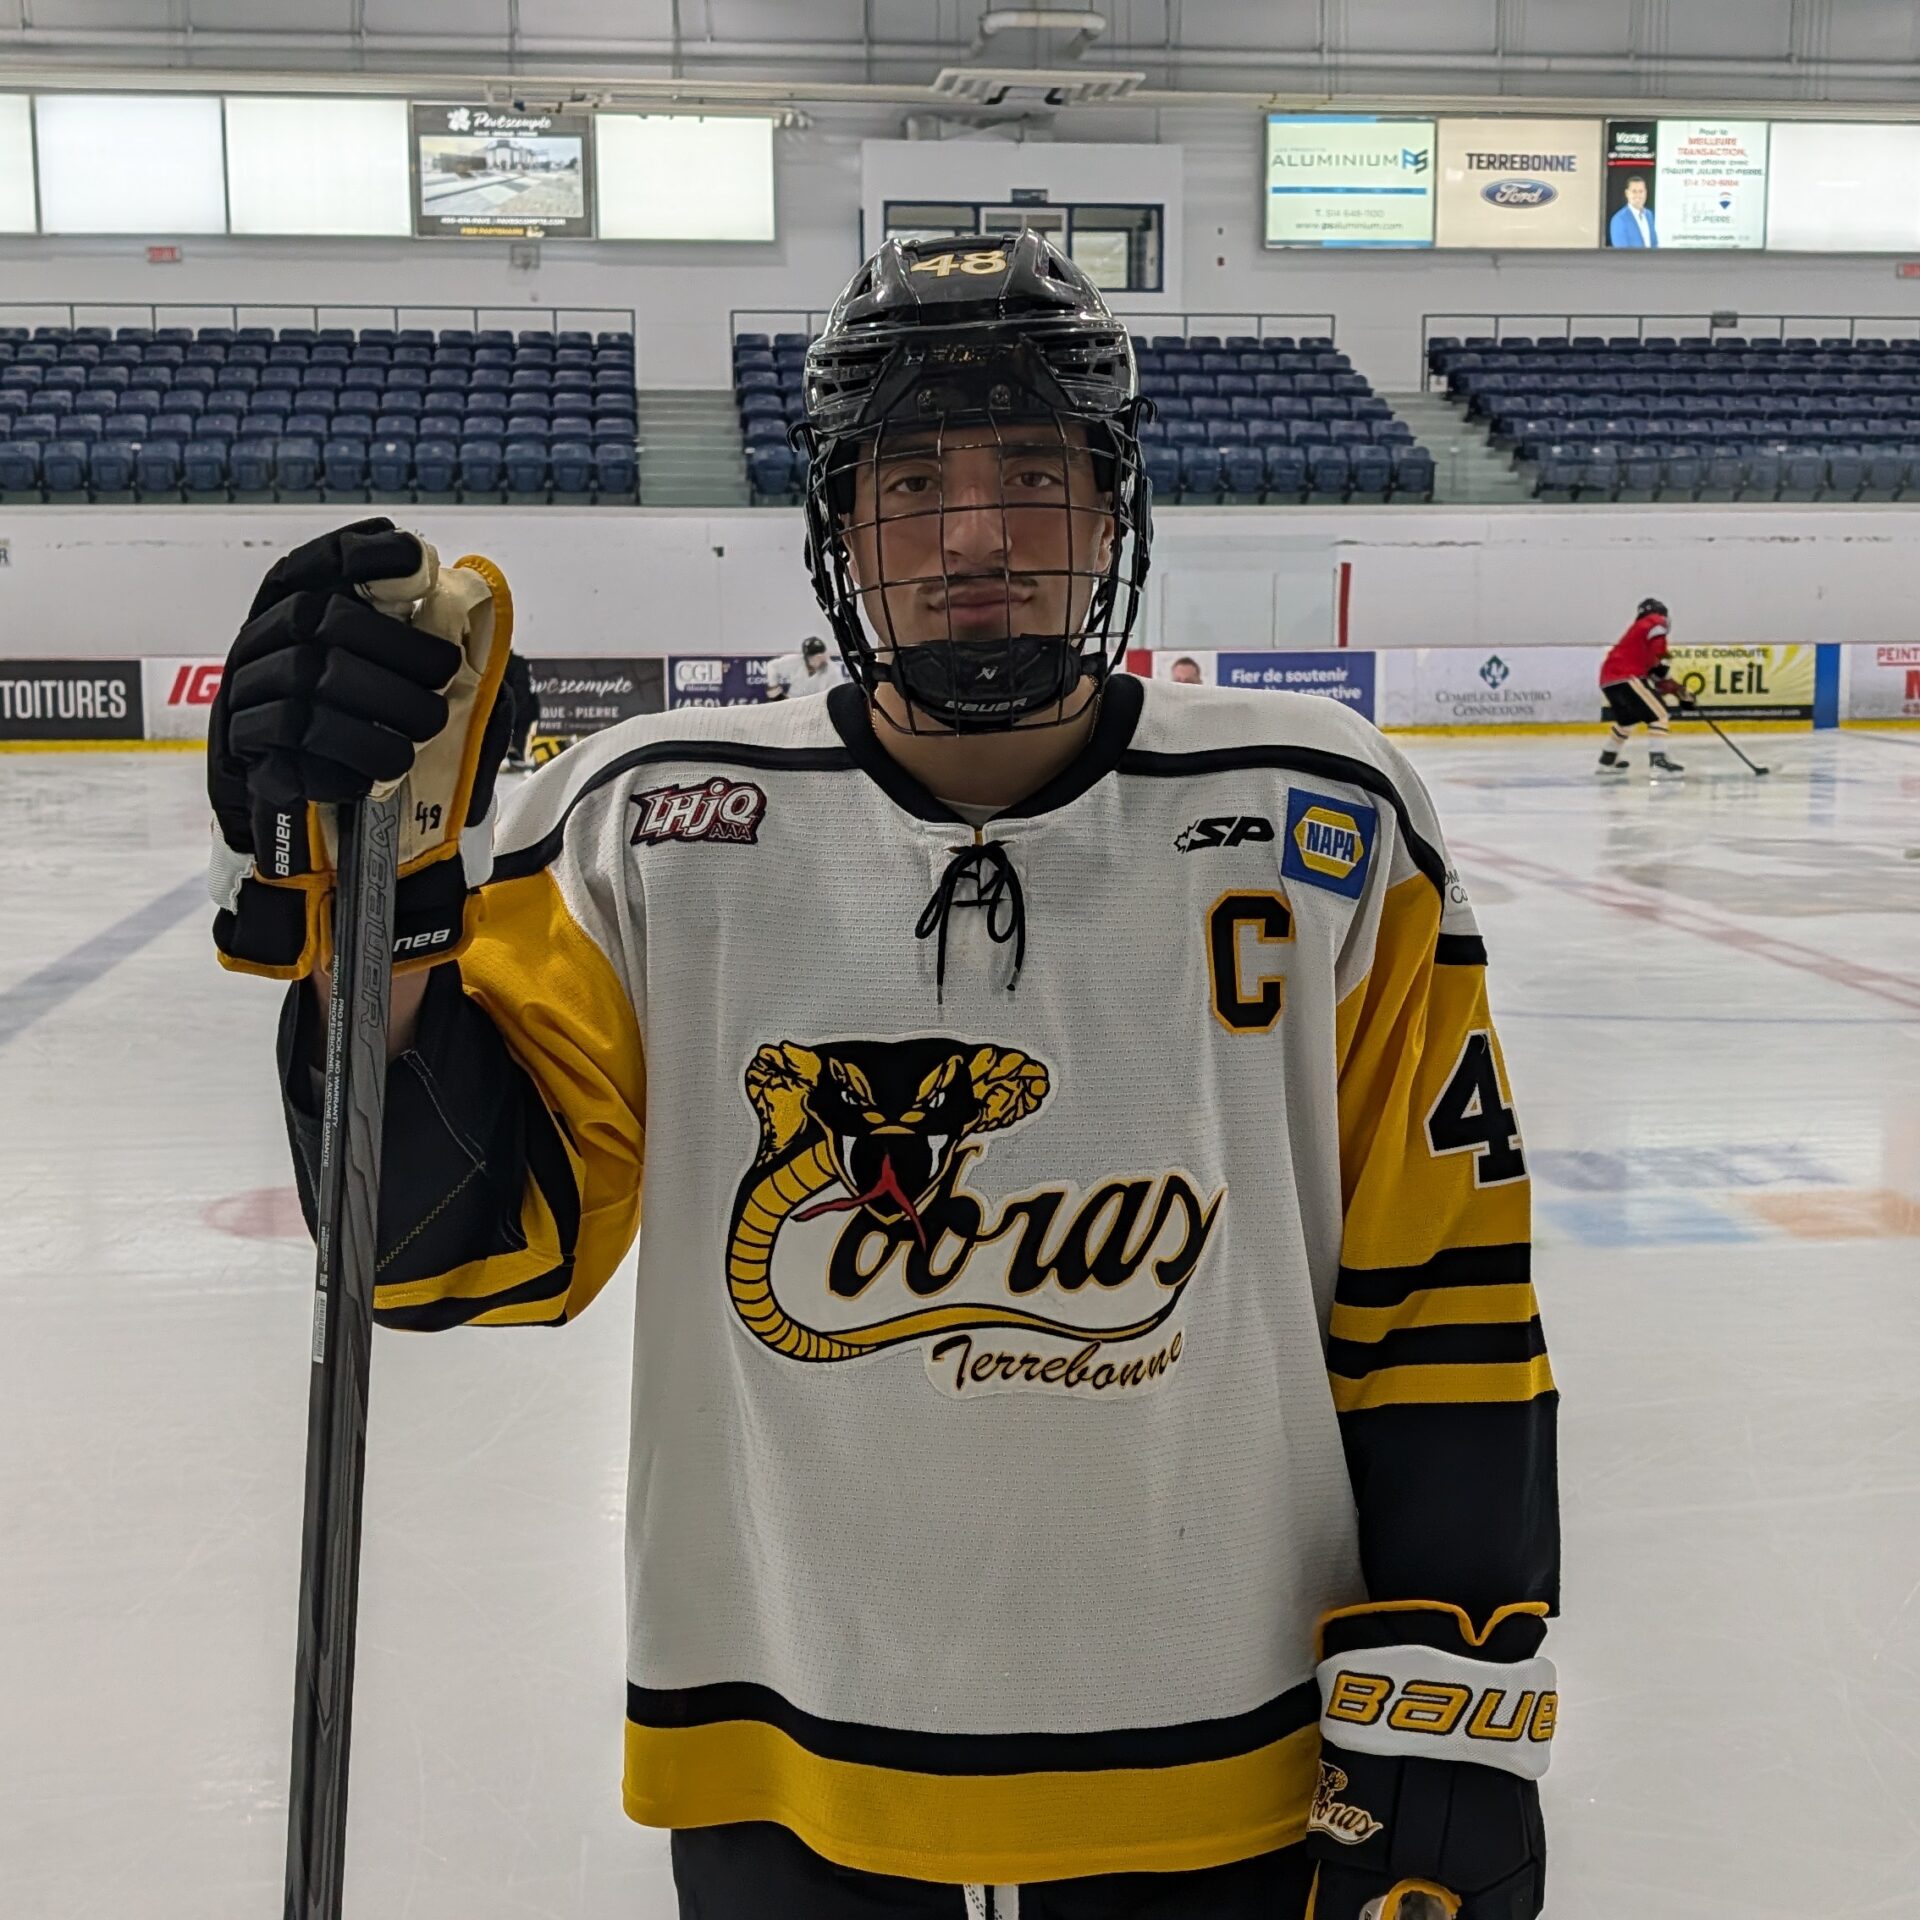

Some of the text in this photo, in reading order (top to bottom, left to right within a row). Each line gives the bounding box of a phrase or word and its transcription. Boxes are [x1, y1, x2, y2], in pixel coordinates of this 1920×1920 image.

[1271, 154, 1399, 168] ALUMINIUM
[1465, 153, 1577, 172] TERREBONNE
[1494, 182, 1542, 205] Ford
[910, 250, 1008, 277] 48
[1712, 648, 1769, 658] CONDUITE
[678, 663, 721, 682] CGL
[1231, 667, 1348, 683] Fier de soutenir
[0, 680, 127, 719] TOITURES
[575, 706, 619, 719] PIERRE
[1304, 820, 1357, 863] NAPA
[1205, 887, 1297, 1035] C
[332, 954, 340, 996] PRODUIT
[337, 998, 345, 1019] PRO
[334, 1060, 341, 1074] NO
[325, 1081, 334, 1120] AUCUNE
[331, 1075, 340, 1128] WARRANTY
[931, 1330, 1183, 1391] Terrebonne
